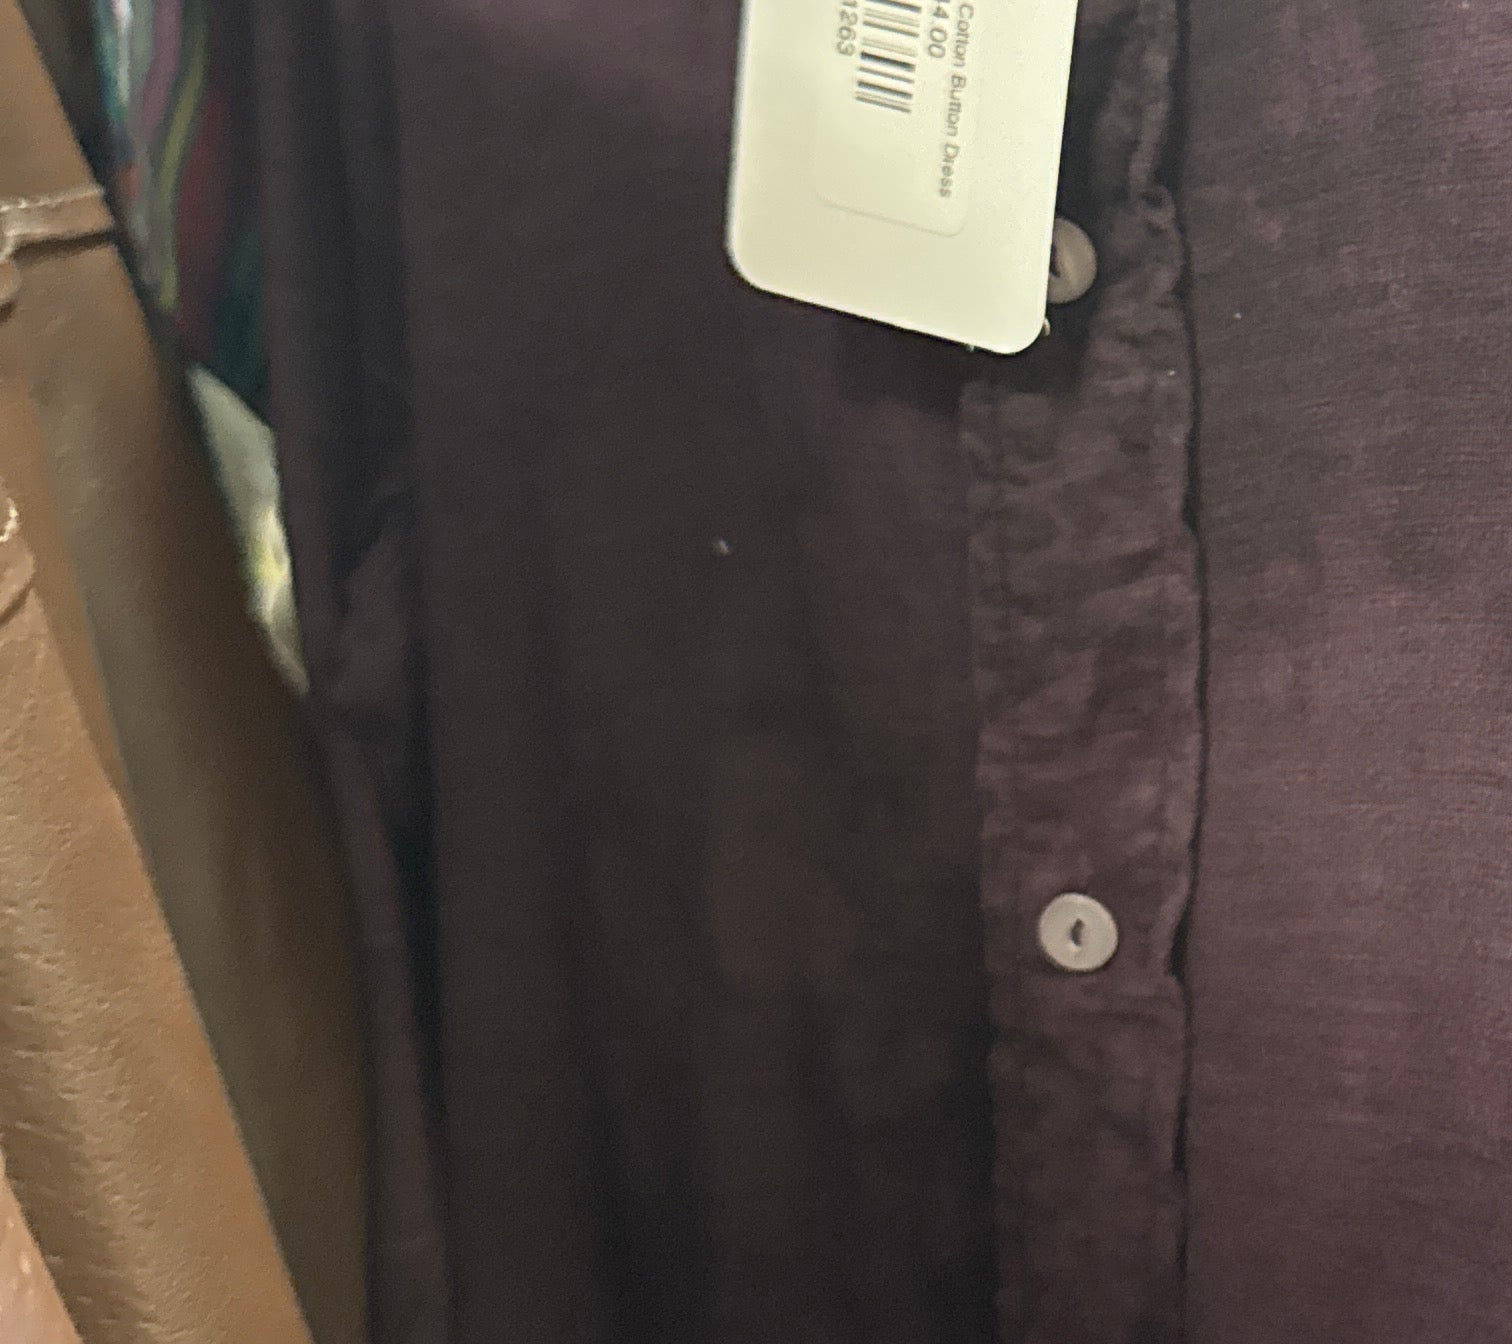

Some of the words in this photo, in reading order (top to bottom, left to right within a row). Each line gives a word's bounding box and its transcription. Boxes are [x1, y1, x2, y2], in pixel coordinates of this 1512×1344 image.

[954, 3, 974, 67] Cotton
[947, 74, 967, 137] Button
[938, 143, 960, 198] Dress
